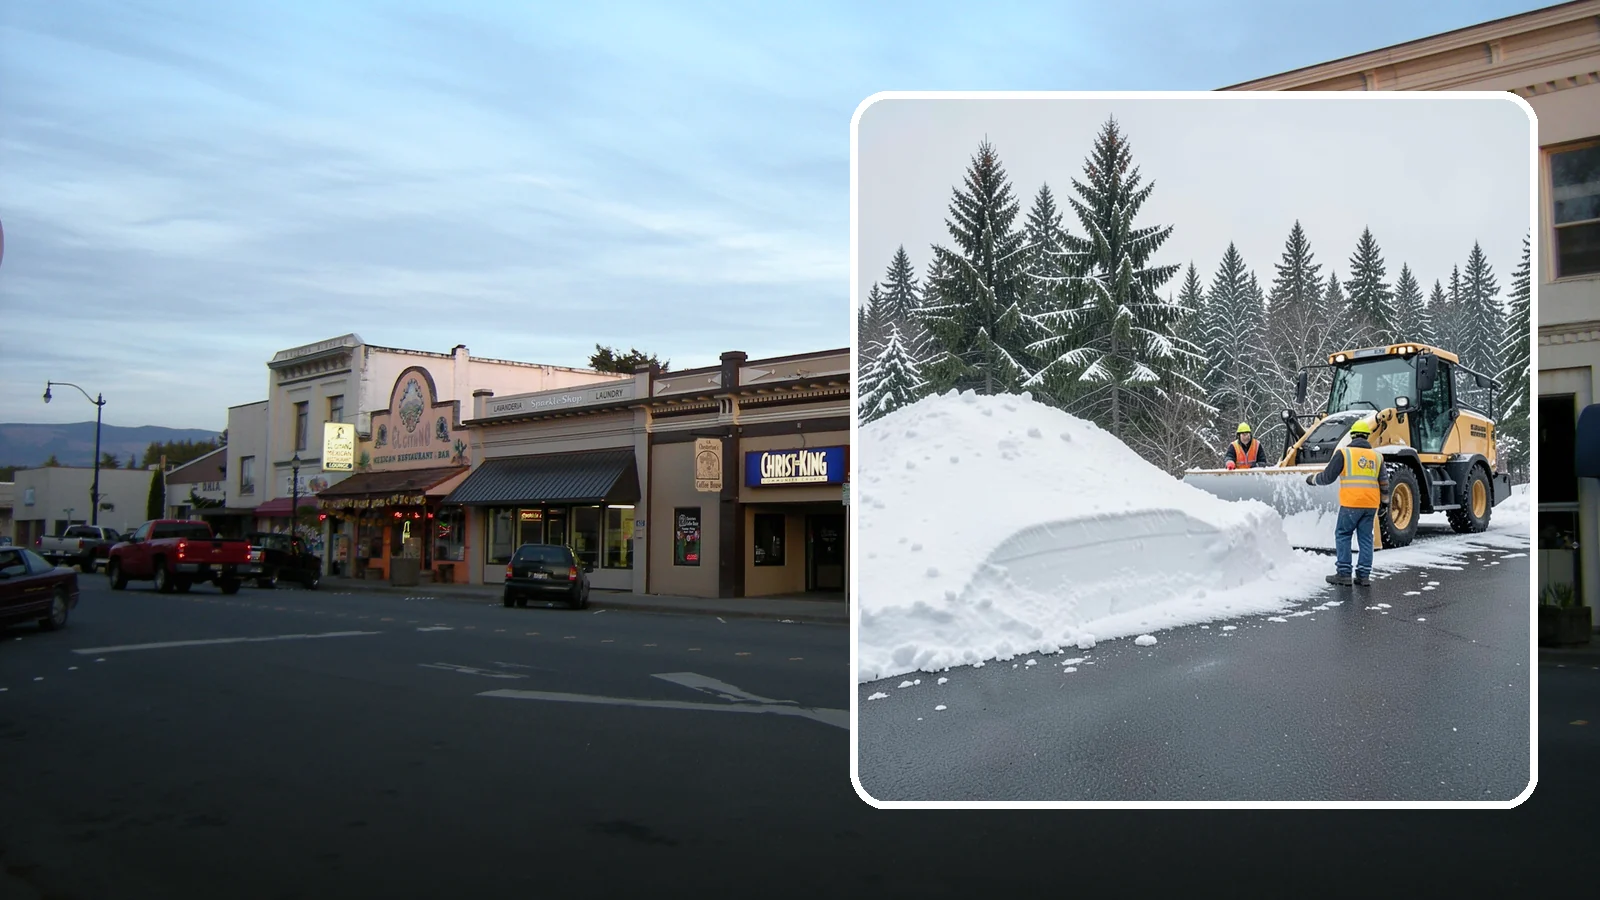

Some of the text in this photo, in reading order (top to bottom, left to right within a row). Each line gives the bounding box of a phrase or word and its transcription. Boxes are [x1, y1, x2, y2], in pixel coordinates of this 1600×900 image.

[493, 389, 623, 412] LAVANDERIA Sparkle Shop LAUNDRY
[397, 451, 433, 462] RESTAURANT
[438, 450, 450, 459] BAR
